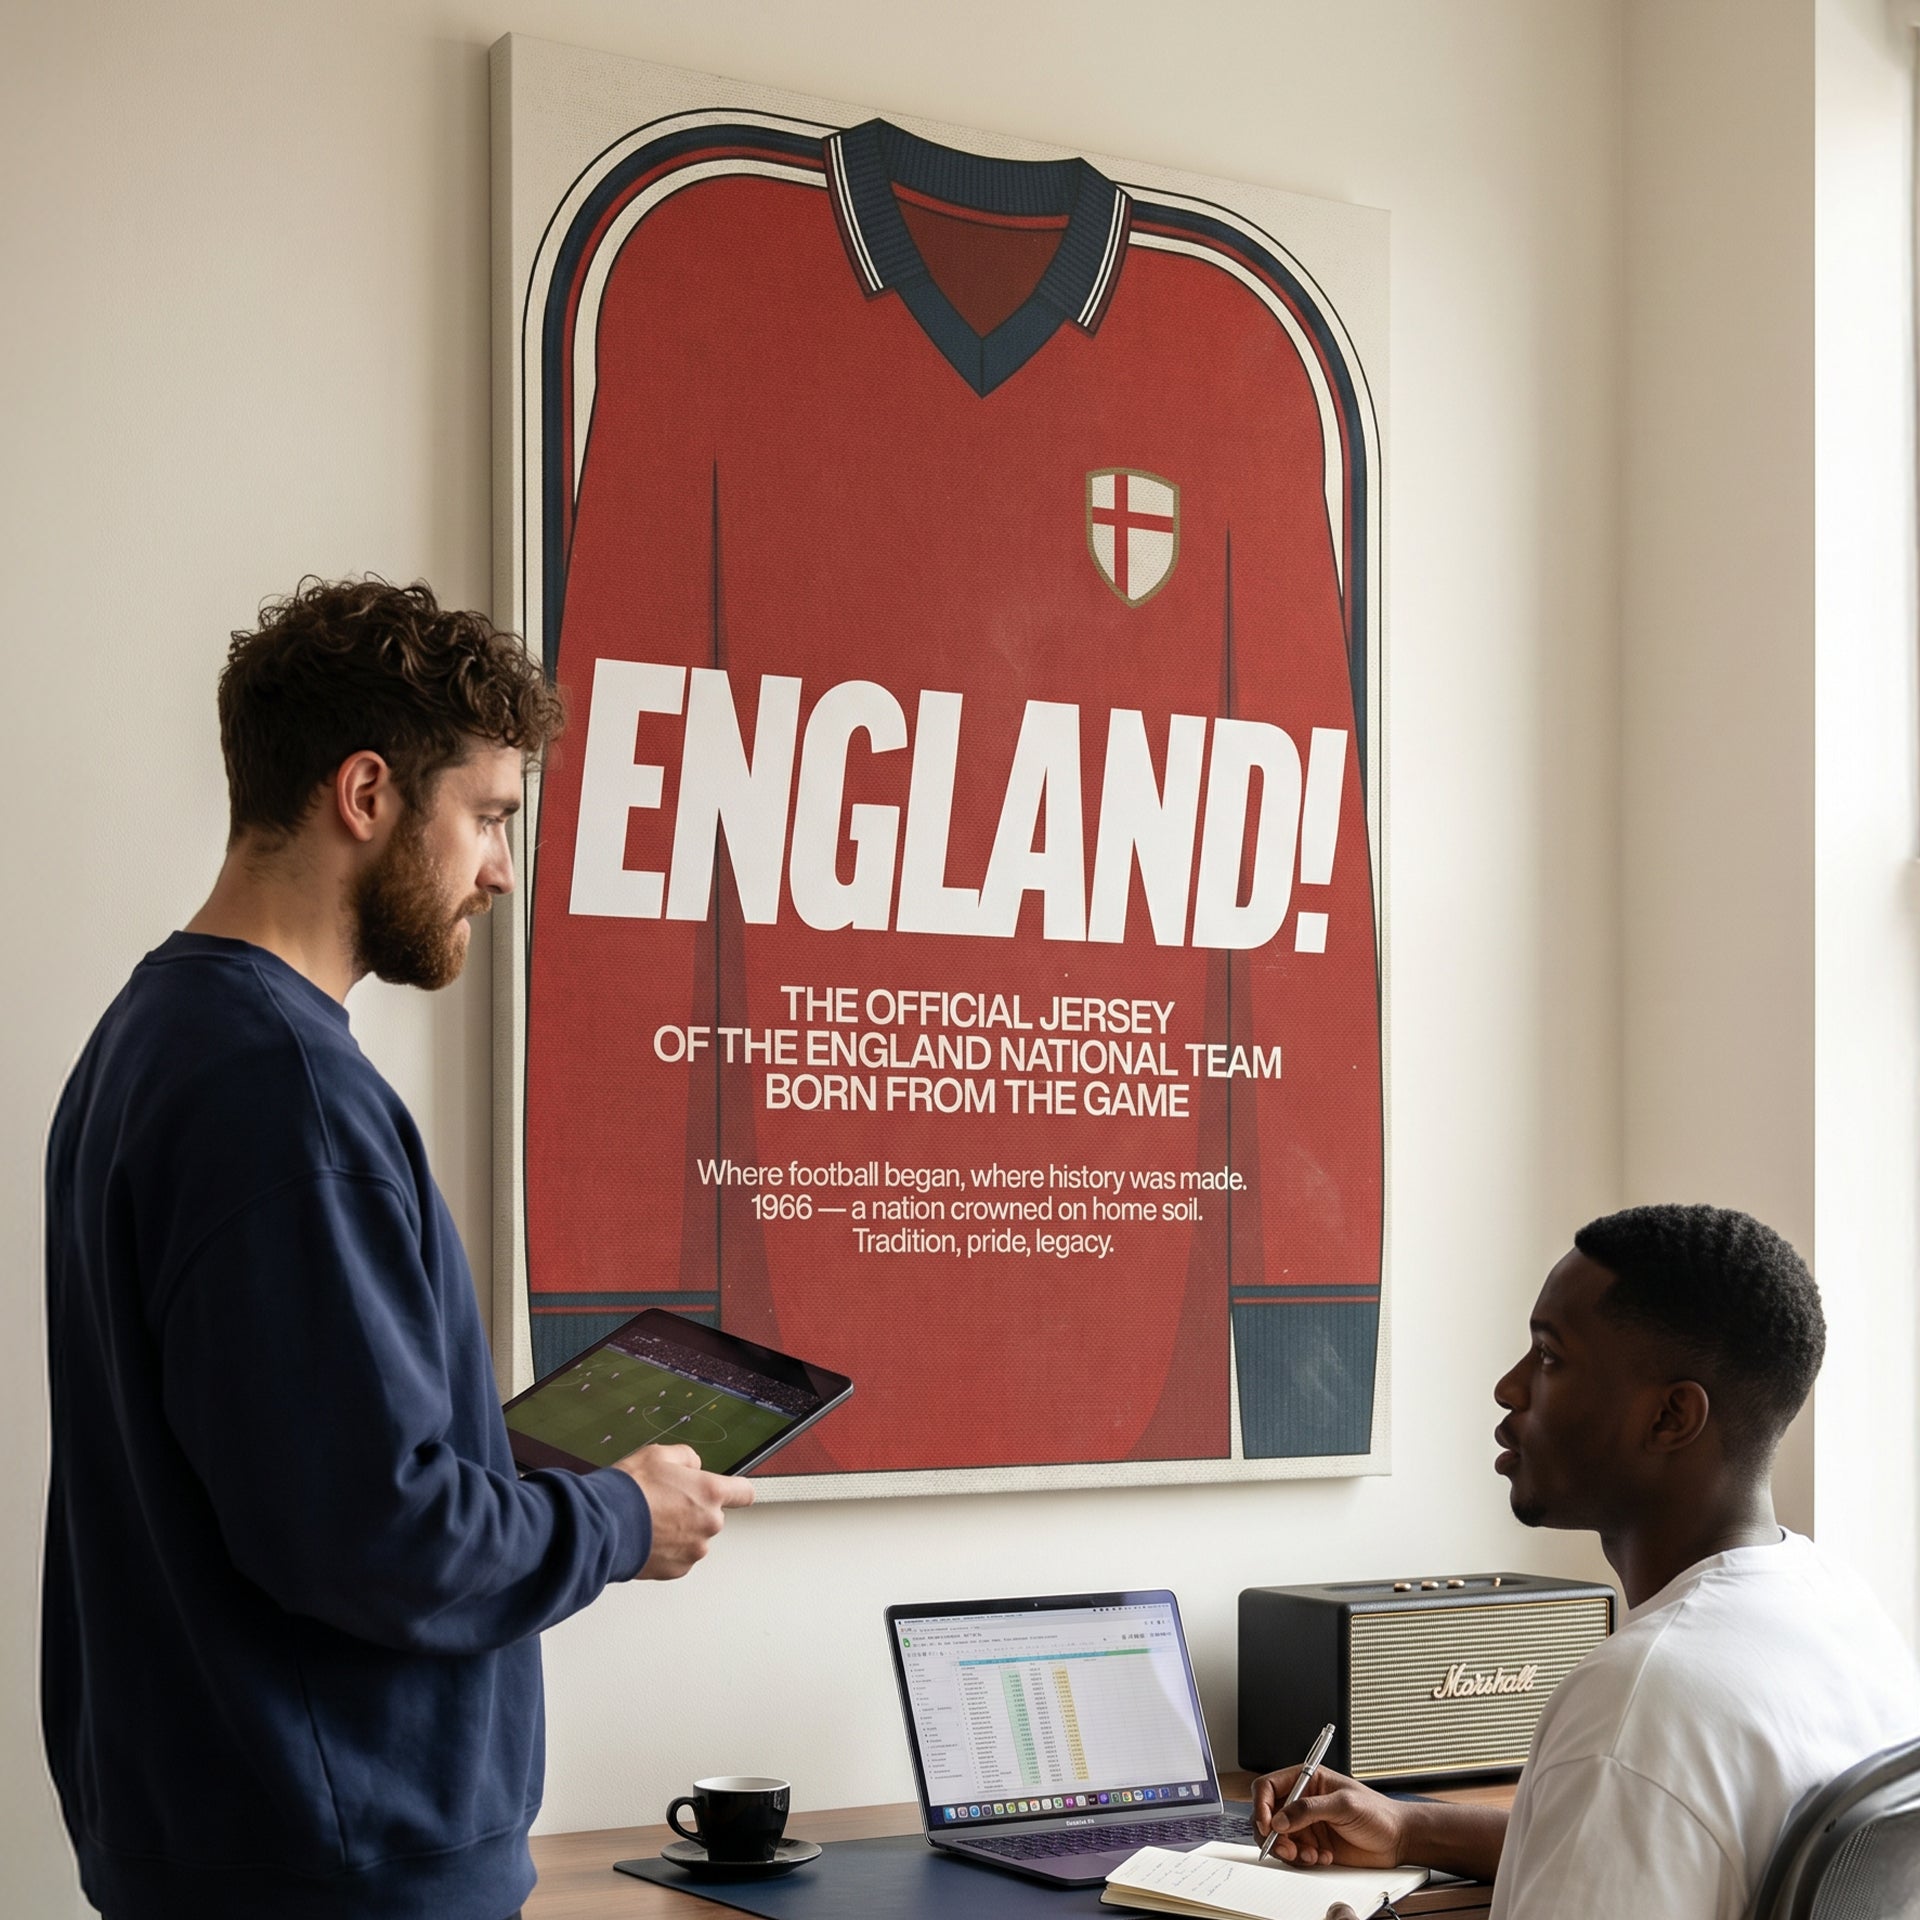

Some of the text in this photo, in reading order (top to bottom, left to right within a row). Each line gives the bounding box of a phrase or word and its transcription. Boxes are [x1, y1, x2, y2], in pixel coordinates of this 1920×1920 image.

[569, 658, 1349, 954] ENGLAND!
[780, 985, 1176, 1035] THE OFFICIAL JERSEY
[653, 1024, 1282, 1080] OF THE ENGLAND NATIONAL TEAM
[766, 1073, 1190, 1118] BORN FROM THE GAME
[696, 1158, 1248, 1195] Where football began, where history was made.
[751, 1193, 813, 1220] 1966
[851, 1200, 867, 1220] a
[872, 1195, 945, 1221] nation
[950, 1195, 1053, 1221] crowned
[1057, 1202, 1088, 1221] on
[1092, 1195, 1158, 1222] home
[1161, 1197, 1203, 1222] soil.
[852, 1227, 1115, 1260] Tradition, pride, legacy.
[1433, 1663, 1538, 1699] Marshall
